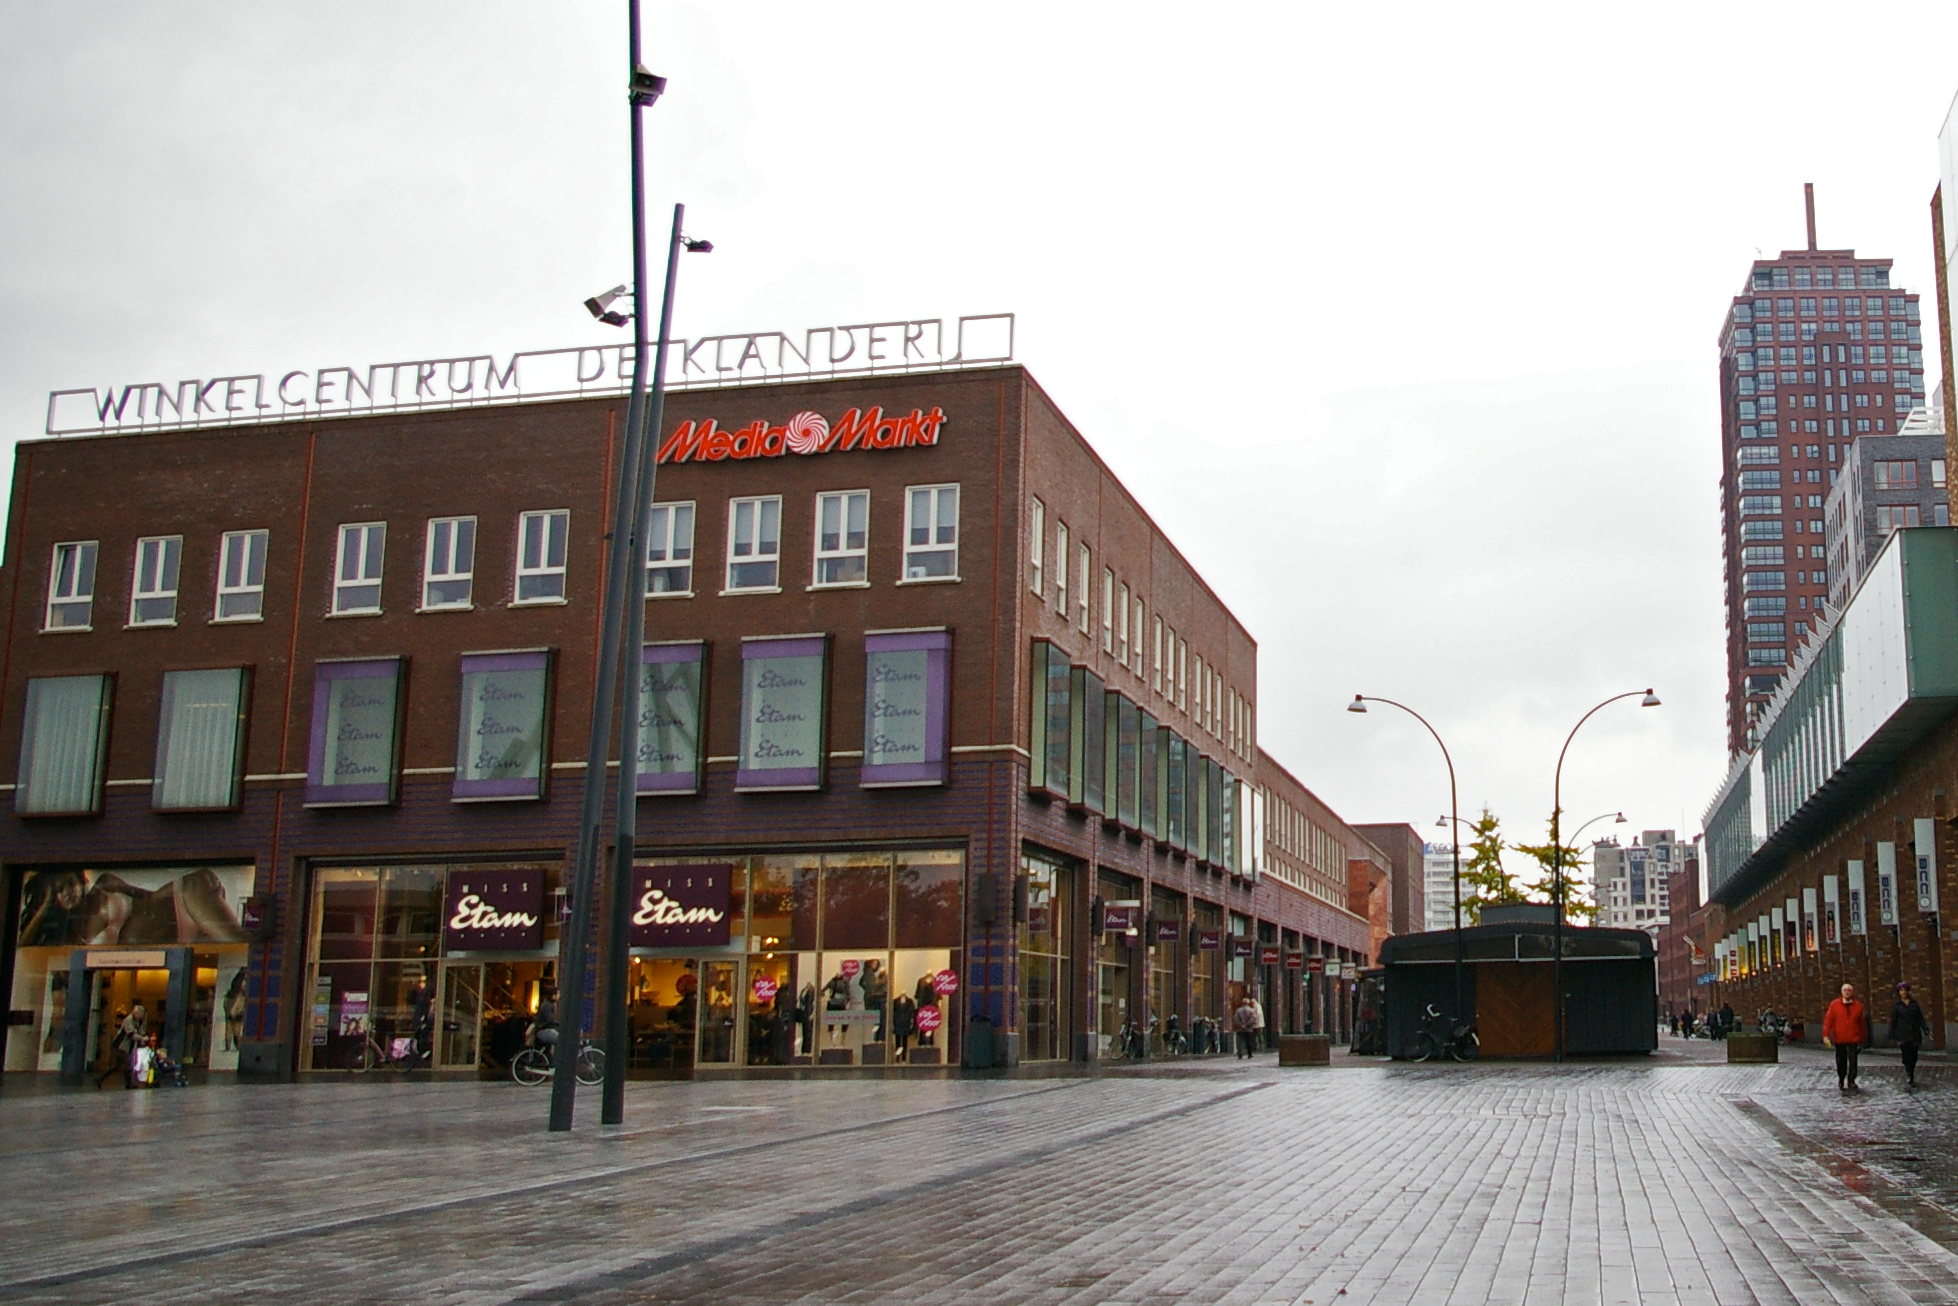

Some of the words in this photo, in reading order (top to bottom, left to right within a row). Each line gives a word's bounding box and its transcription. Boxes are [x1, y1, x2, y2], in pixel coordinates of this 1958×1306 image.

[94, 353, 519, 422] WINKELCENTRUM
[577, 345, 636, 382] DE
[682, 317, 963, 374] KLANDERIJ
[655, 418, 789, 464] Media
[818, 405, 947, 452] Markt
[757, 669, 806, 688] Etam
[874, 664, 921, 683] Etam
[480, 682, 524, 701] Etam
[640, 674, 687, 693] Etam
[639, 709, 685, 728] Etam
[755, 704, 805, 723] Etam
[873, 700, 921, 718] Etam
[478, 717, 523, 735] Etam
[754, 738, 804, 758] Etam
[872, 734, 920, 753] Etam
[475, 751, 521, 769] Etam
[638, 744, 683, 763] Etam
[462, 882, 528, 893] MISS
[645, 877, 714, 888] MISS
[450, 894, 538, 930] Etam
[632, 889, 724, 926] Etam
